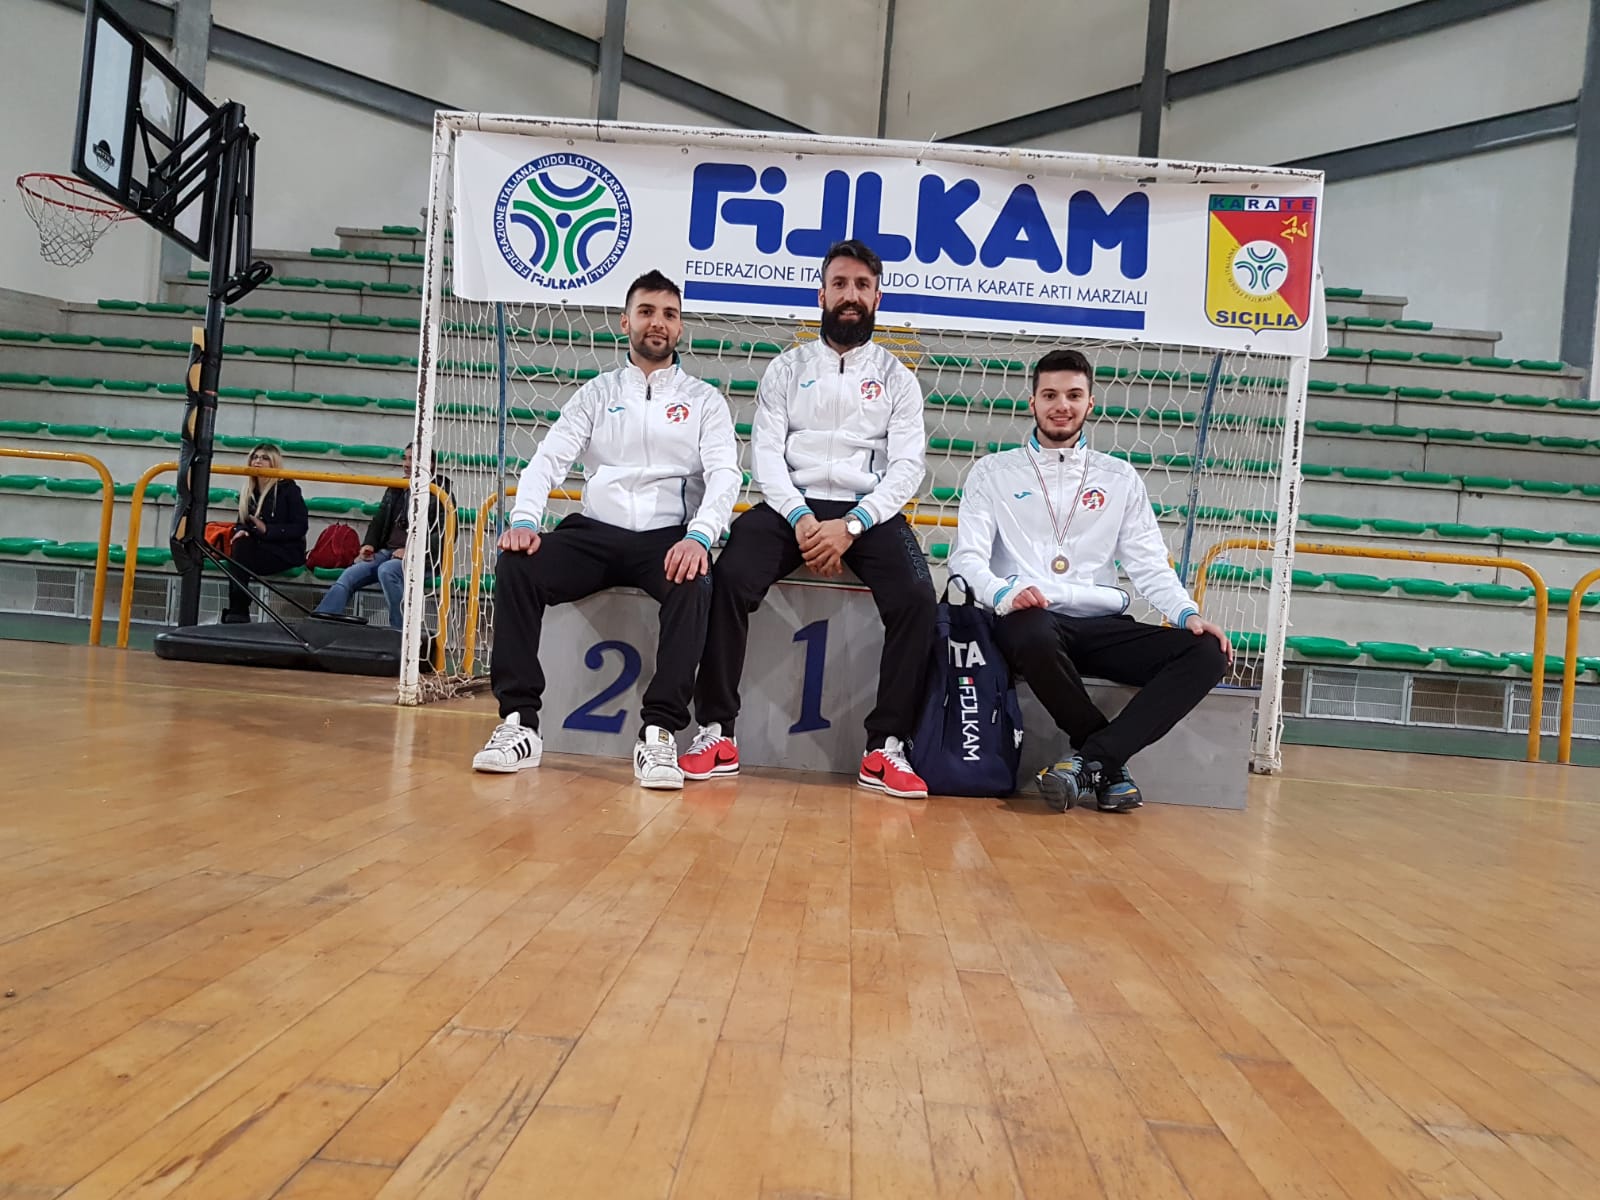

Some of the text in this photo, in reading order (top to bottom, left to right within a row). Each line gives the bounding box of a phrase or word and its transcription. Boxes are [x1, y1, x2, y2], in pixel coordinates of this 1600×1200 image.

[496, 155, 630, 282] FEDERAZIONE ITALIANA JUDO LOTTA KARATE ARTI MARZIALI
[1213, 198, 1314, 210] KARATE
[685, 260, 795, 281] FEDERAZIONE
[880, 272, 919, 288] UDO
[925, 275, 972, 292] LOTTA
[978, 279, 1035, 297] KARATE
[1039, 284, 1072, 300] ARTI
[1077, 287, 1148, 305] MARZIALI
[1215, 310, 1298, 327] SICILIA
[562, 640, 642, 734] 2
[788, 619, 831, 735] 1
